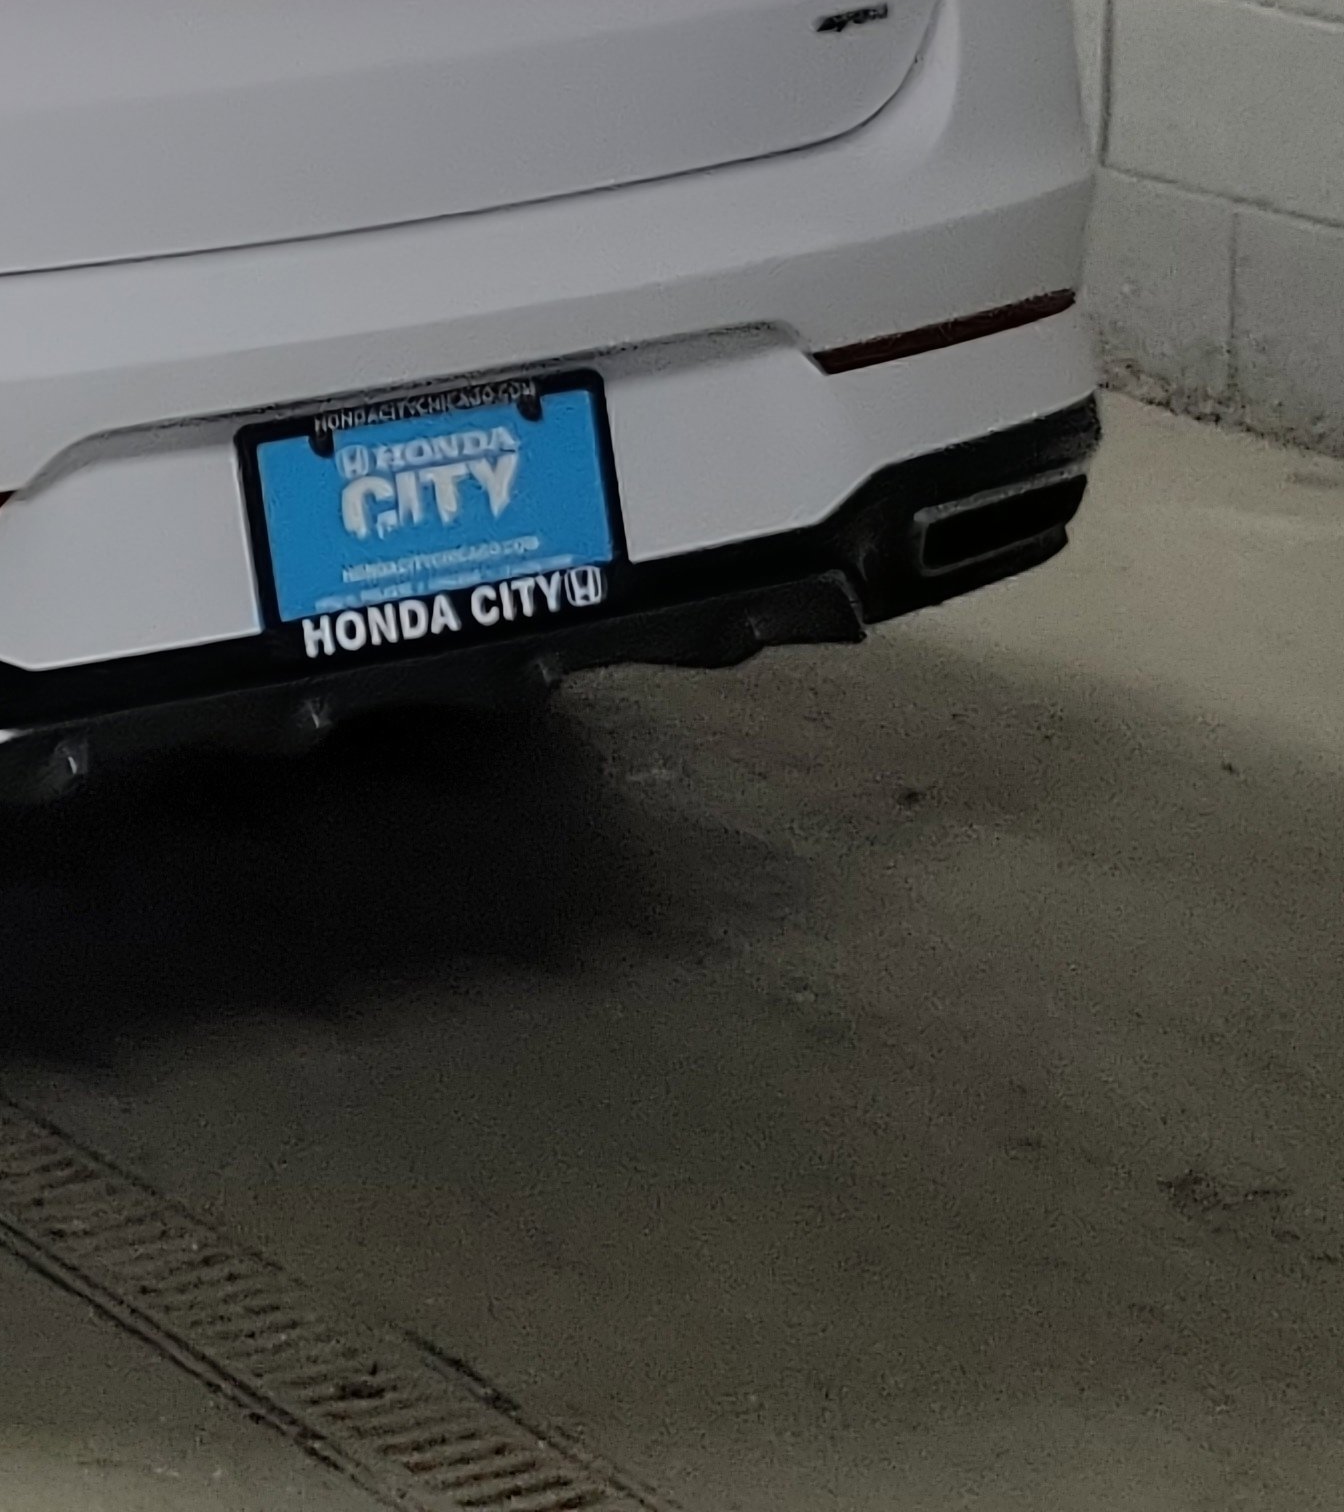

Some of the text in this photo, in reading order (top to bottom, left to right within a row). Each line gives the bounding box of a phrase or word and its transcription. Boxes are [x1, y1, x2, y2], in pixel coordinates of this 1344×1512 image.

[376, 426, 521, 469] HONDA
[342, 452, 523, 539] CITY
[302, 594, 461, 658] HONDA
[470, 571, 561, 626] CITY
